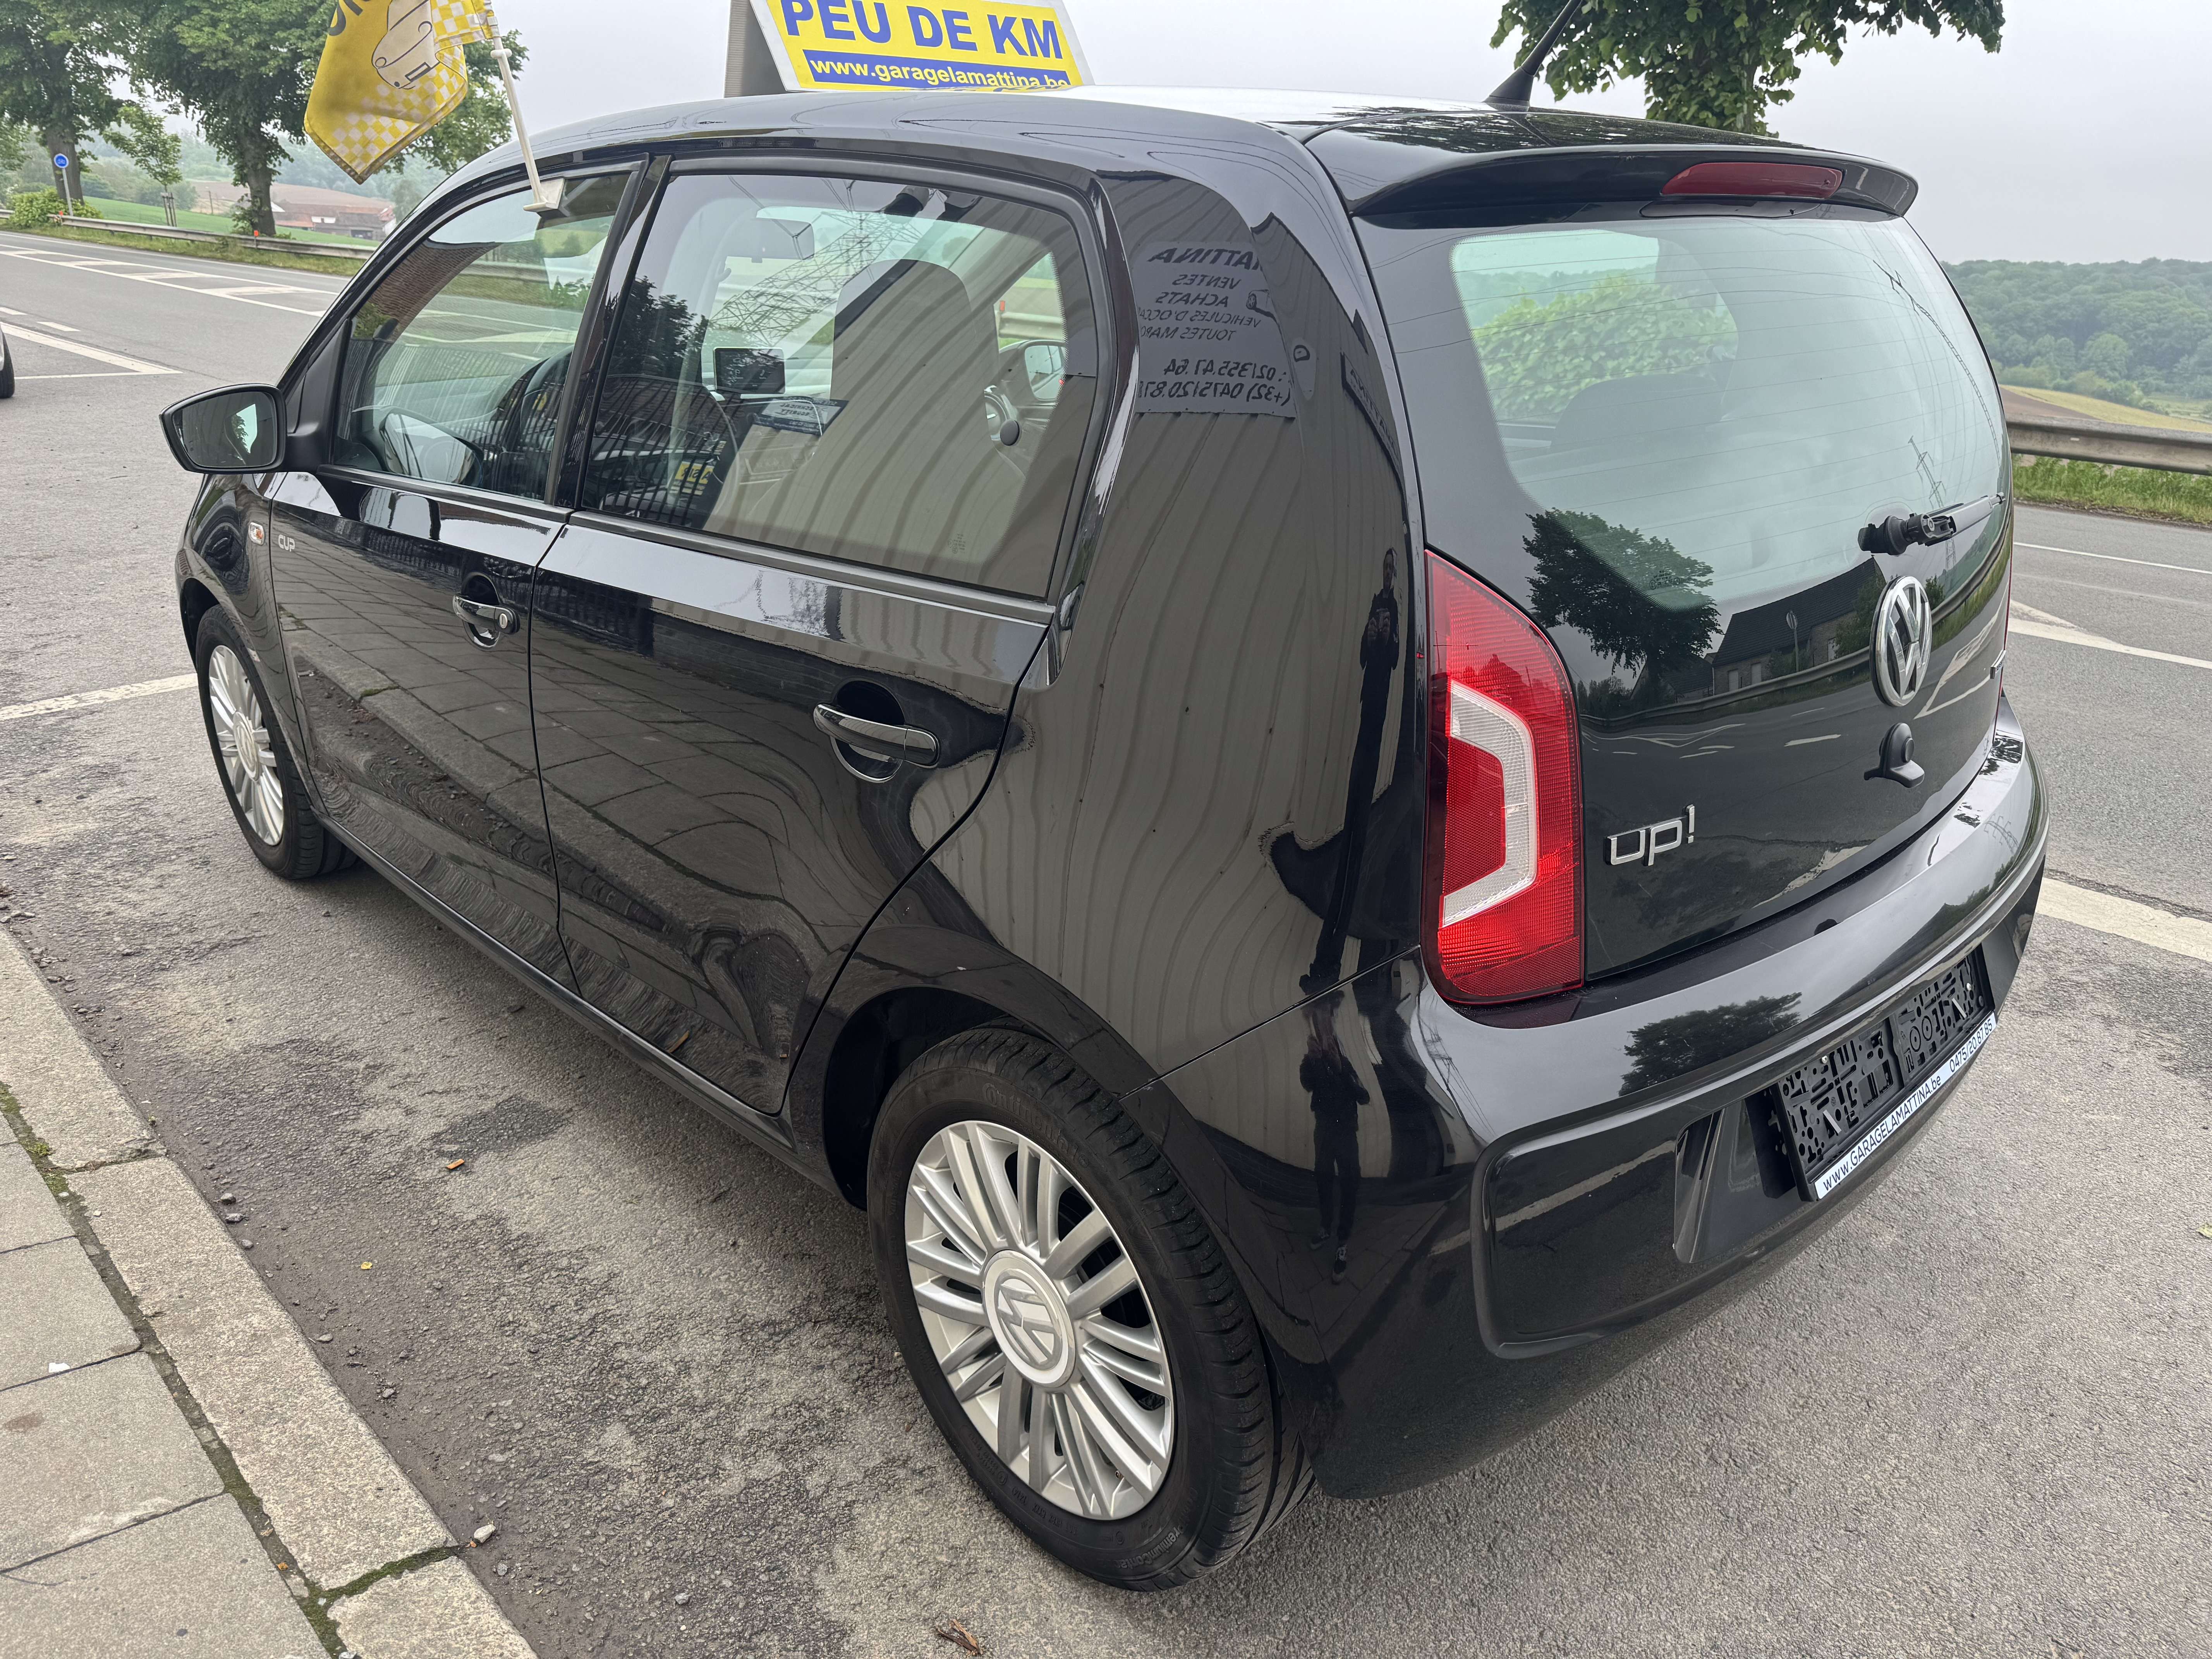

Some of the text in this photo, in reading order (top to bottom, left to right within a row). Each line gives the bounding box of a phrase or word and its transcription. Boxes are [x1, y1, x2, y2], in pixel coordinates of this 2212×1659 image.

[781, 0, 1063, 59] PEU DE KM
[810, 60, 1069, 87] www.garagelamattinab
[1607, 804, 1695, 866] up!
[1949, 1018, 1993, 1073] 0475/20.87.85
